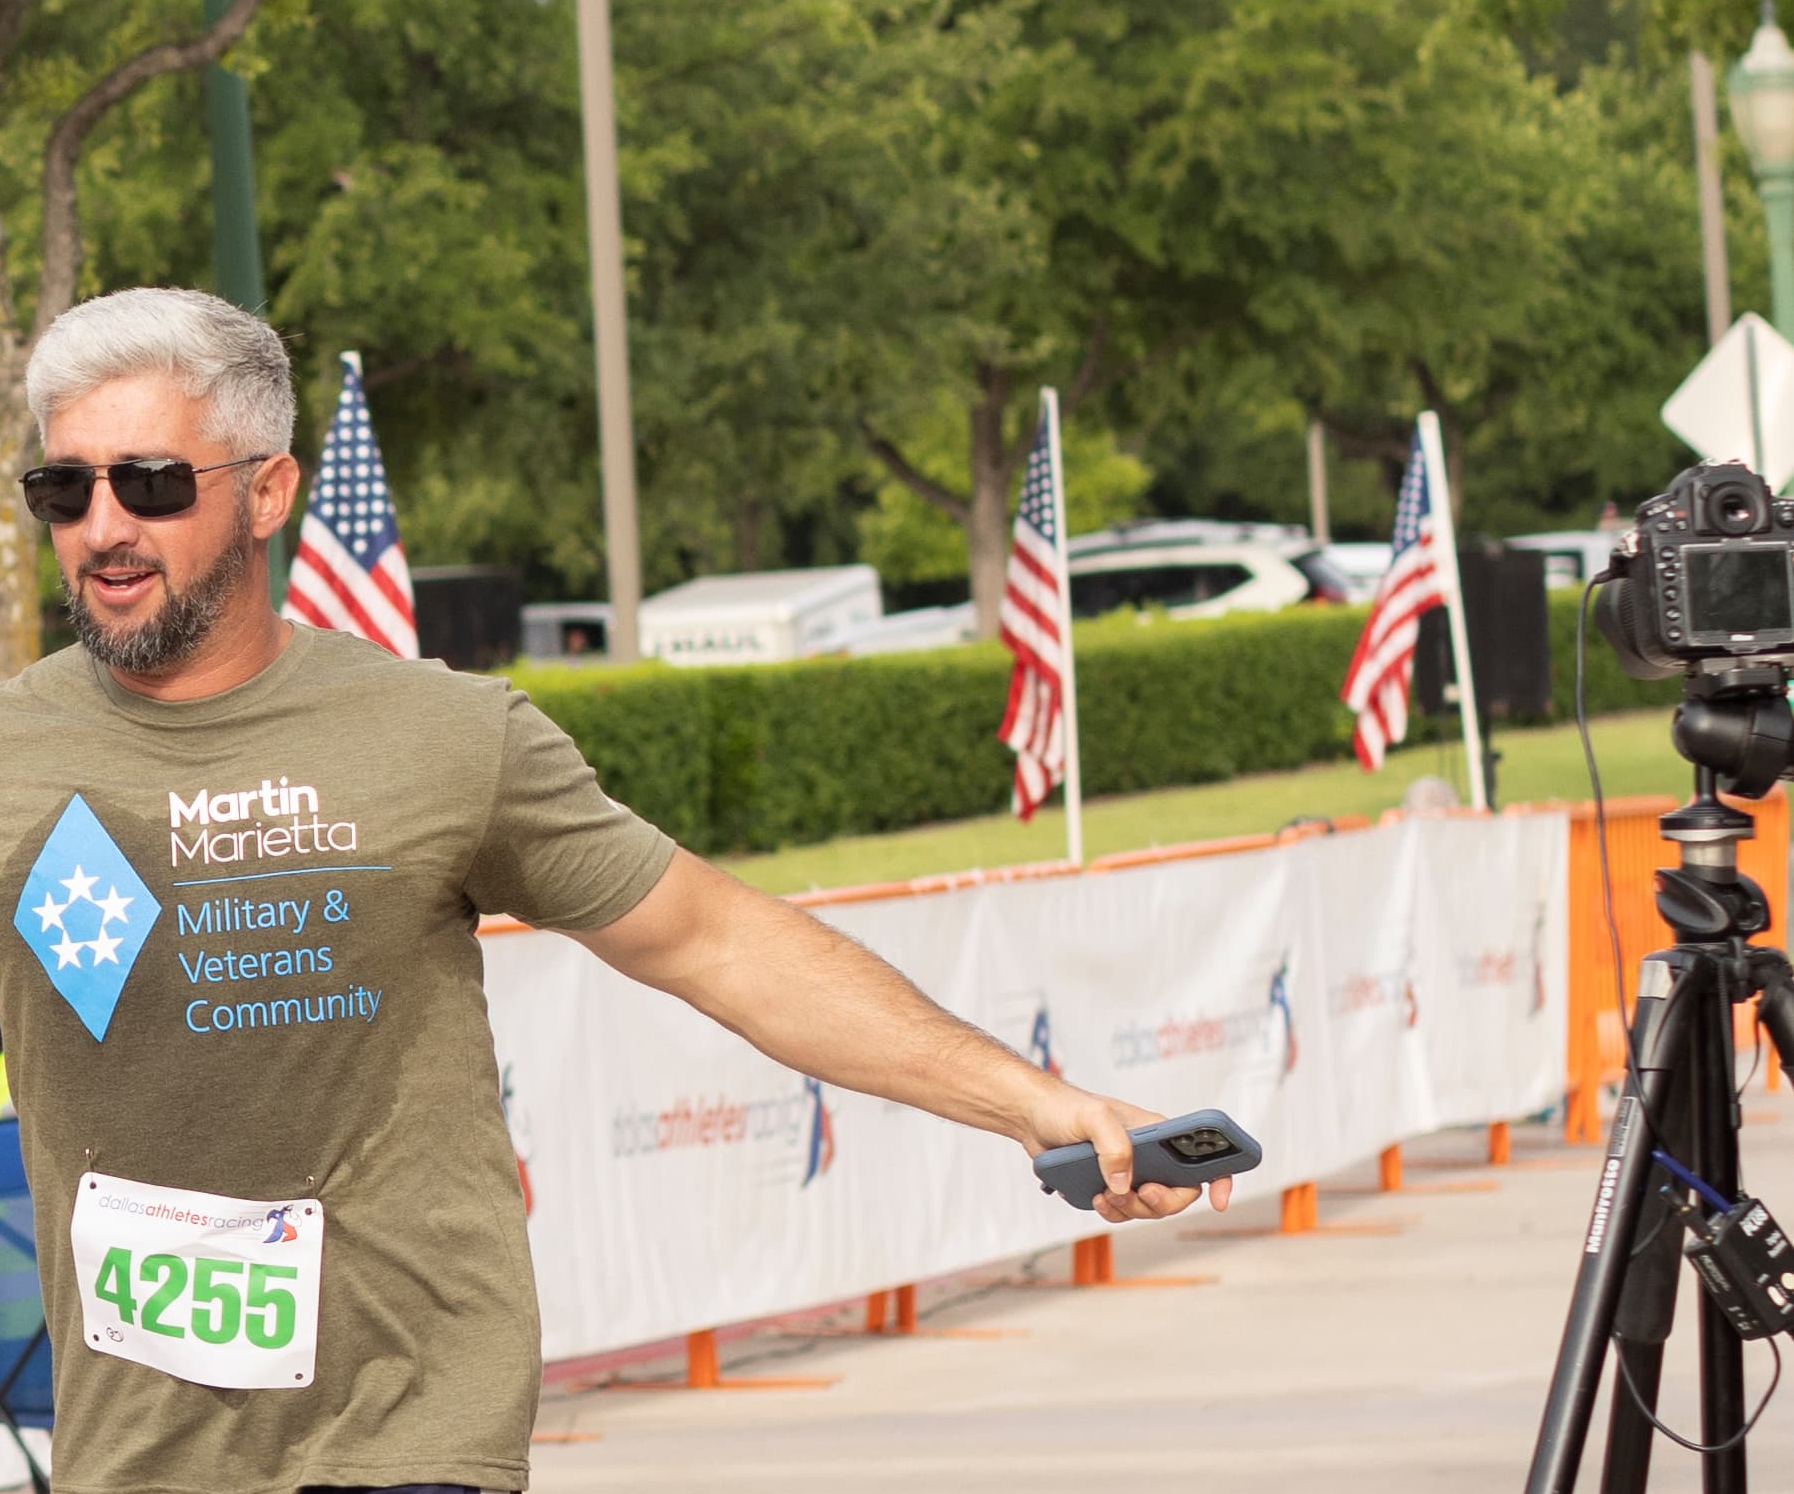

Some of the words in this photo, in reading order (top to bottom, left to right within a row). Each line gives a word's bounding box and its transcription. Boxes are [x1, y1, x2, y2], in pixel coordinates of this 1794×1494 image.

[168, 776, 319, 828] Martin
[170, 814, 357, 867] Marietta
[176, 897, 311, 936] Military
[323, 889, 350, 922] &
[178, 945, 333, 984] Veterans
[185, 984, 382, 1033] Community
[98, 1194, 264, 1231] dallasathletesracing
[1585, 1158, 1621, 1253] Manfrotto
[94, 1246, 298, 1350] 4255
